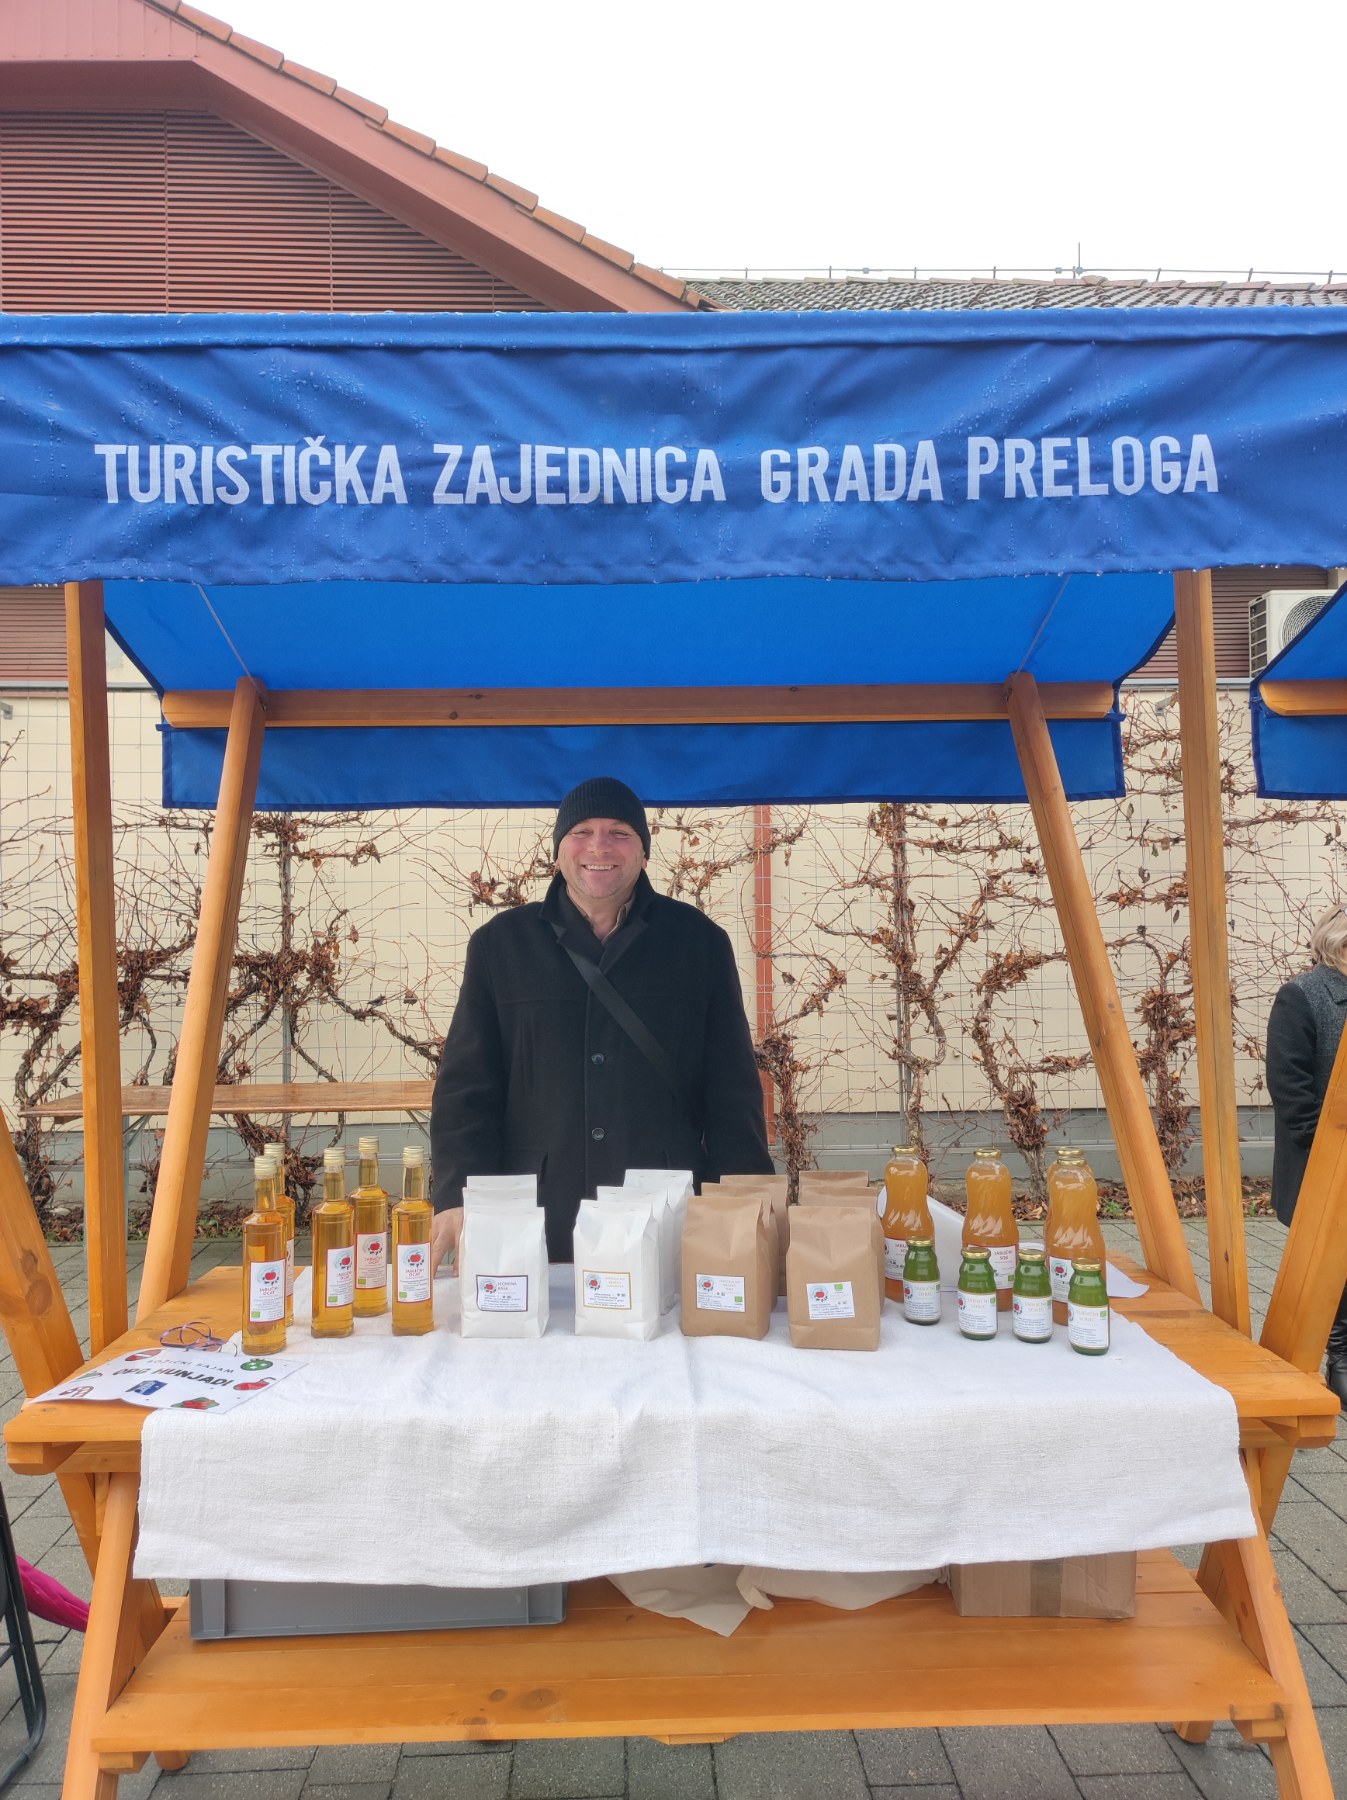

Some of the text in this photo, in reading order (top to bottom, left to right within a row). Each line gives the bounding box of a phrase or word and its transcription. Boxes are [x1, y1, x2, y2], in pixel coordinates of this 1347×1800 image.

[94, 433, 1219, 505] TURISTIČKA ZAJEDNICA GRADA PRELOGA
[151, 1368, 235, 1386] HUNJADI
